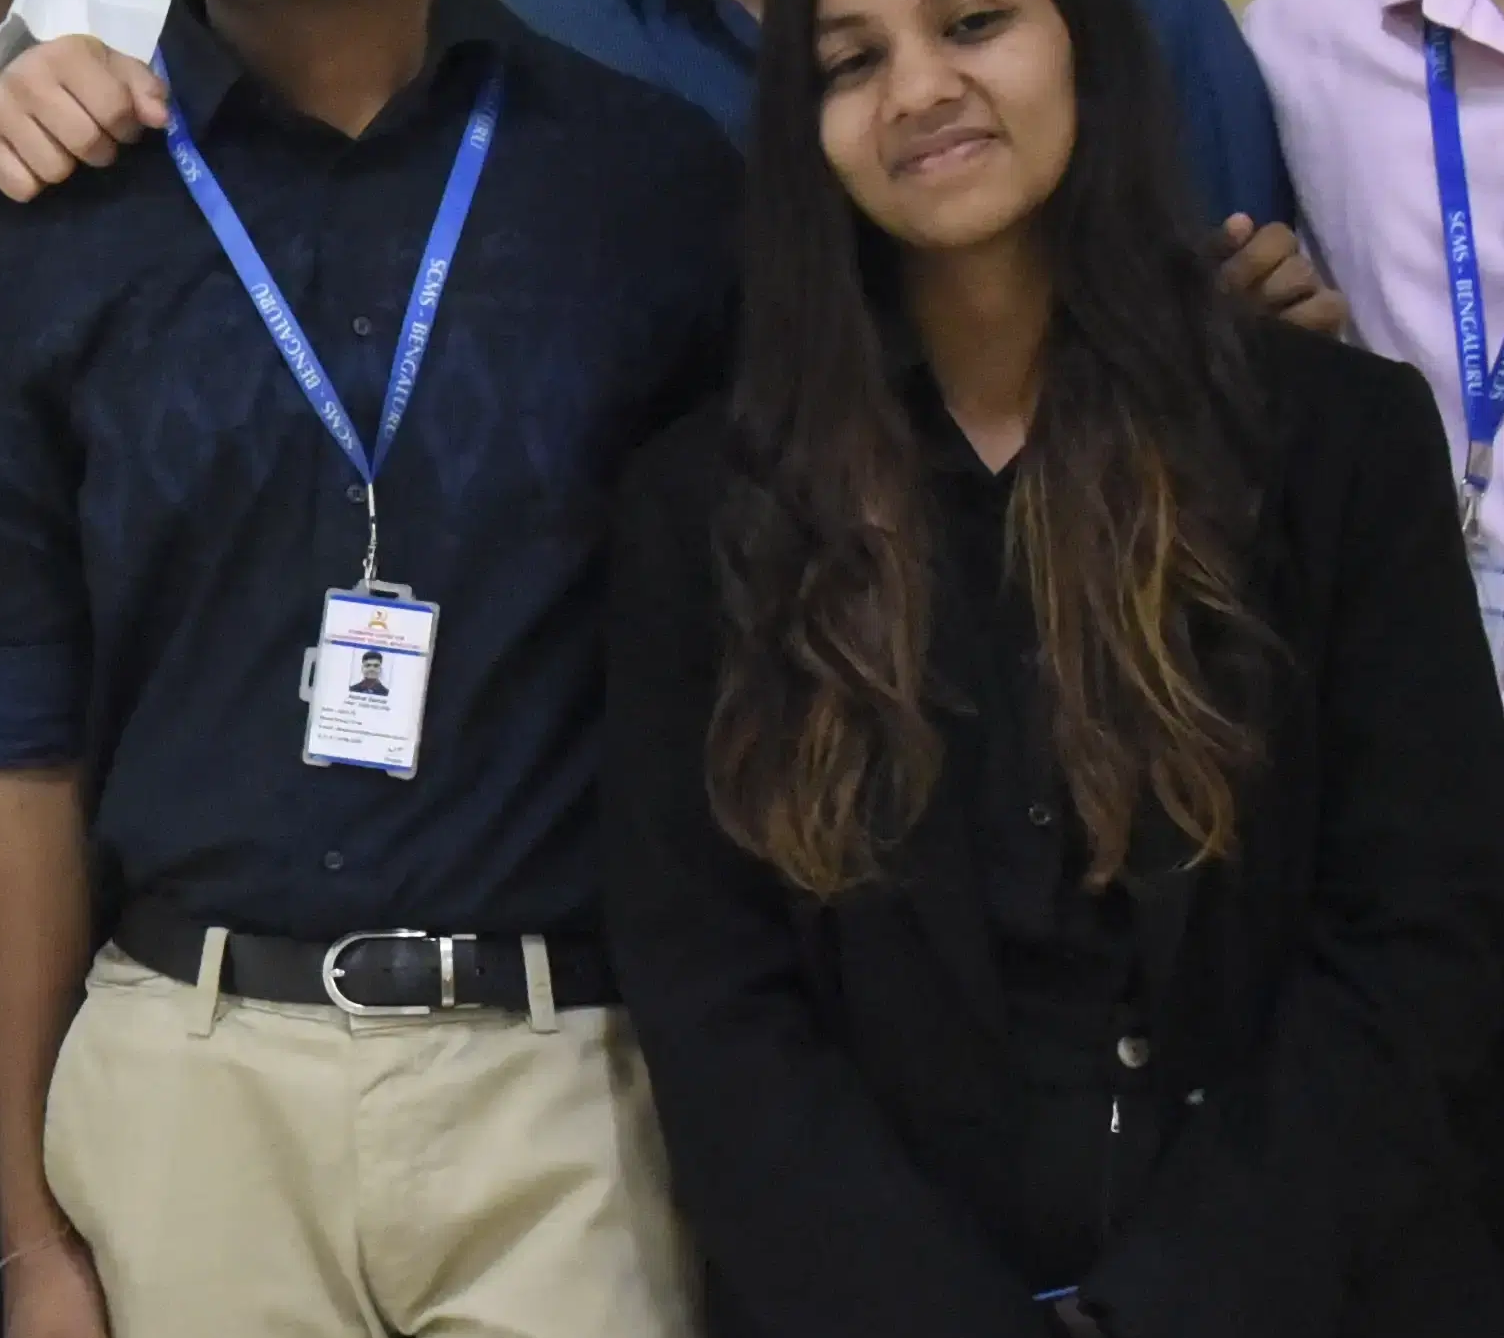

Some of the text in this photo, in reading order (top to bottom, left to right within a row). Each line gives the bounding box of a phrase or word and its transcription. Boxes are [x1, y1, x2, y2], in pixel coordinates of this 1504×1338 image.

[1449, 211, 1467, 262] SCMS
[419, 258, 446, 307] SCMS
[250, 282, 321, 391] BENGALURU
[1455, 279, 1484, 397] BENGALURU
[321, 400, 355, 450] SCMS
